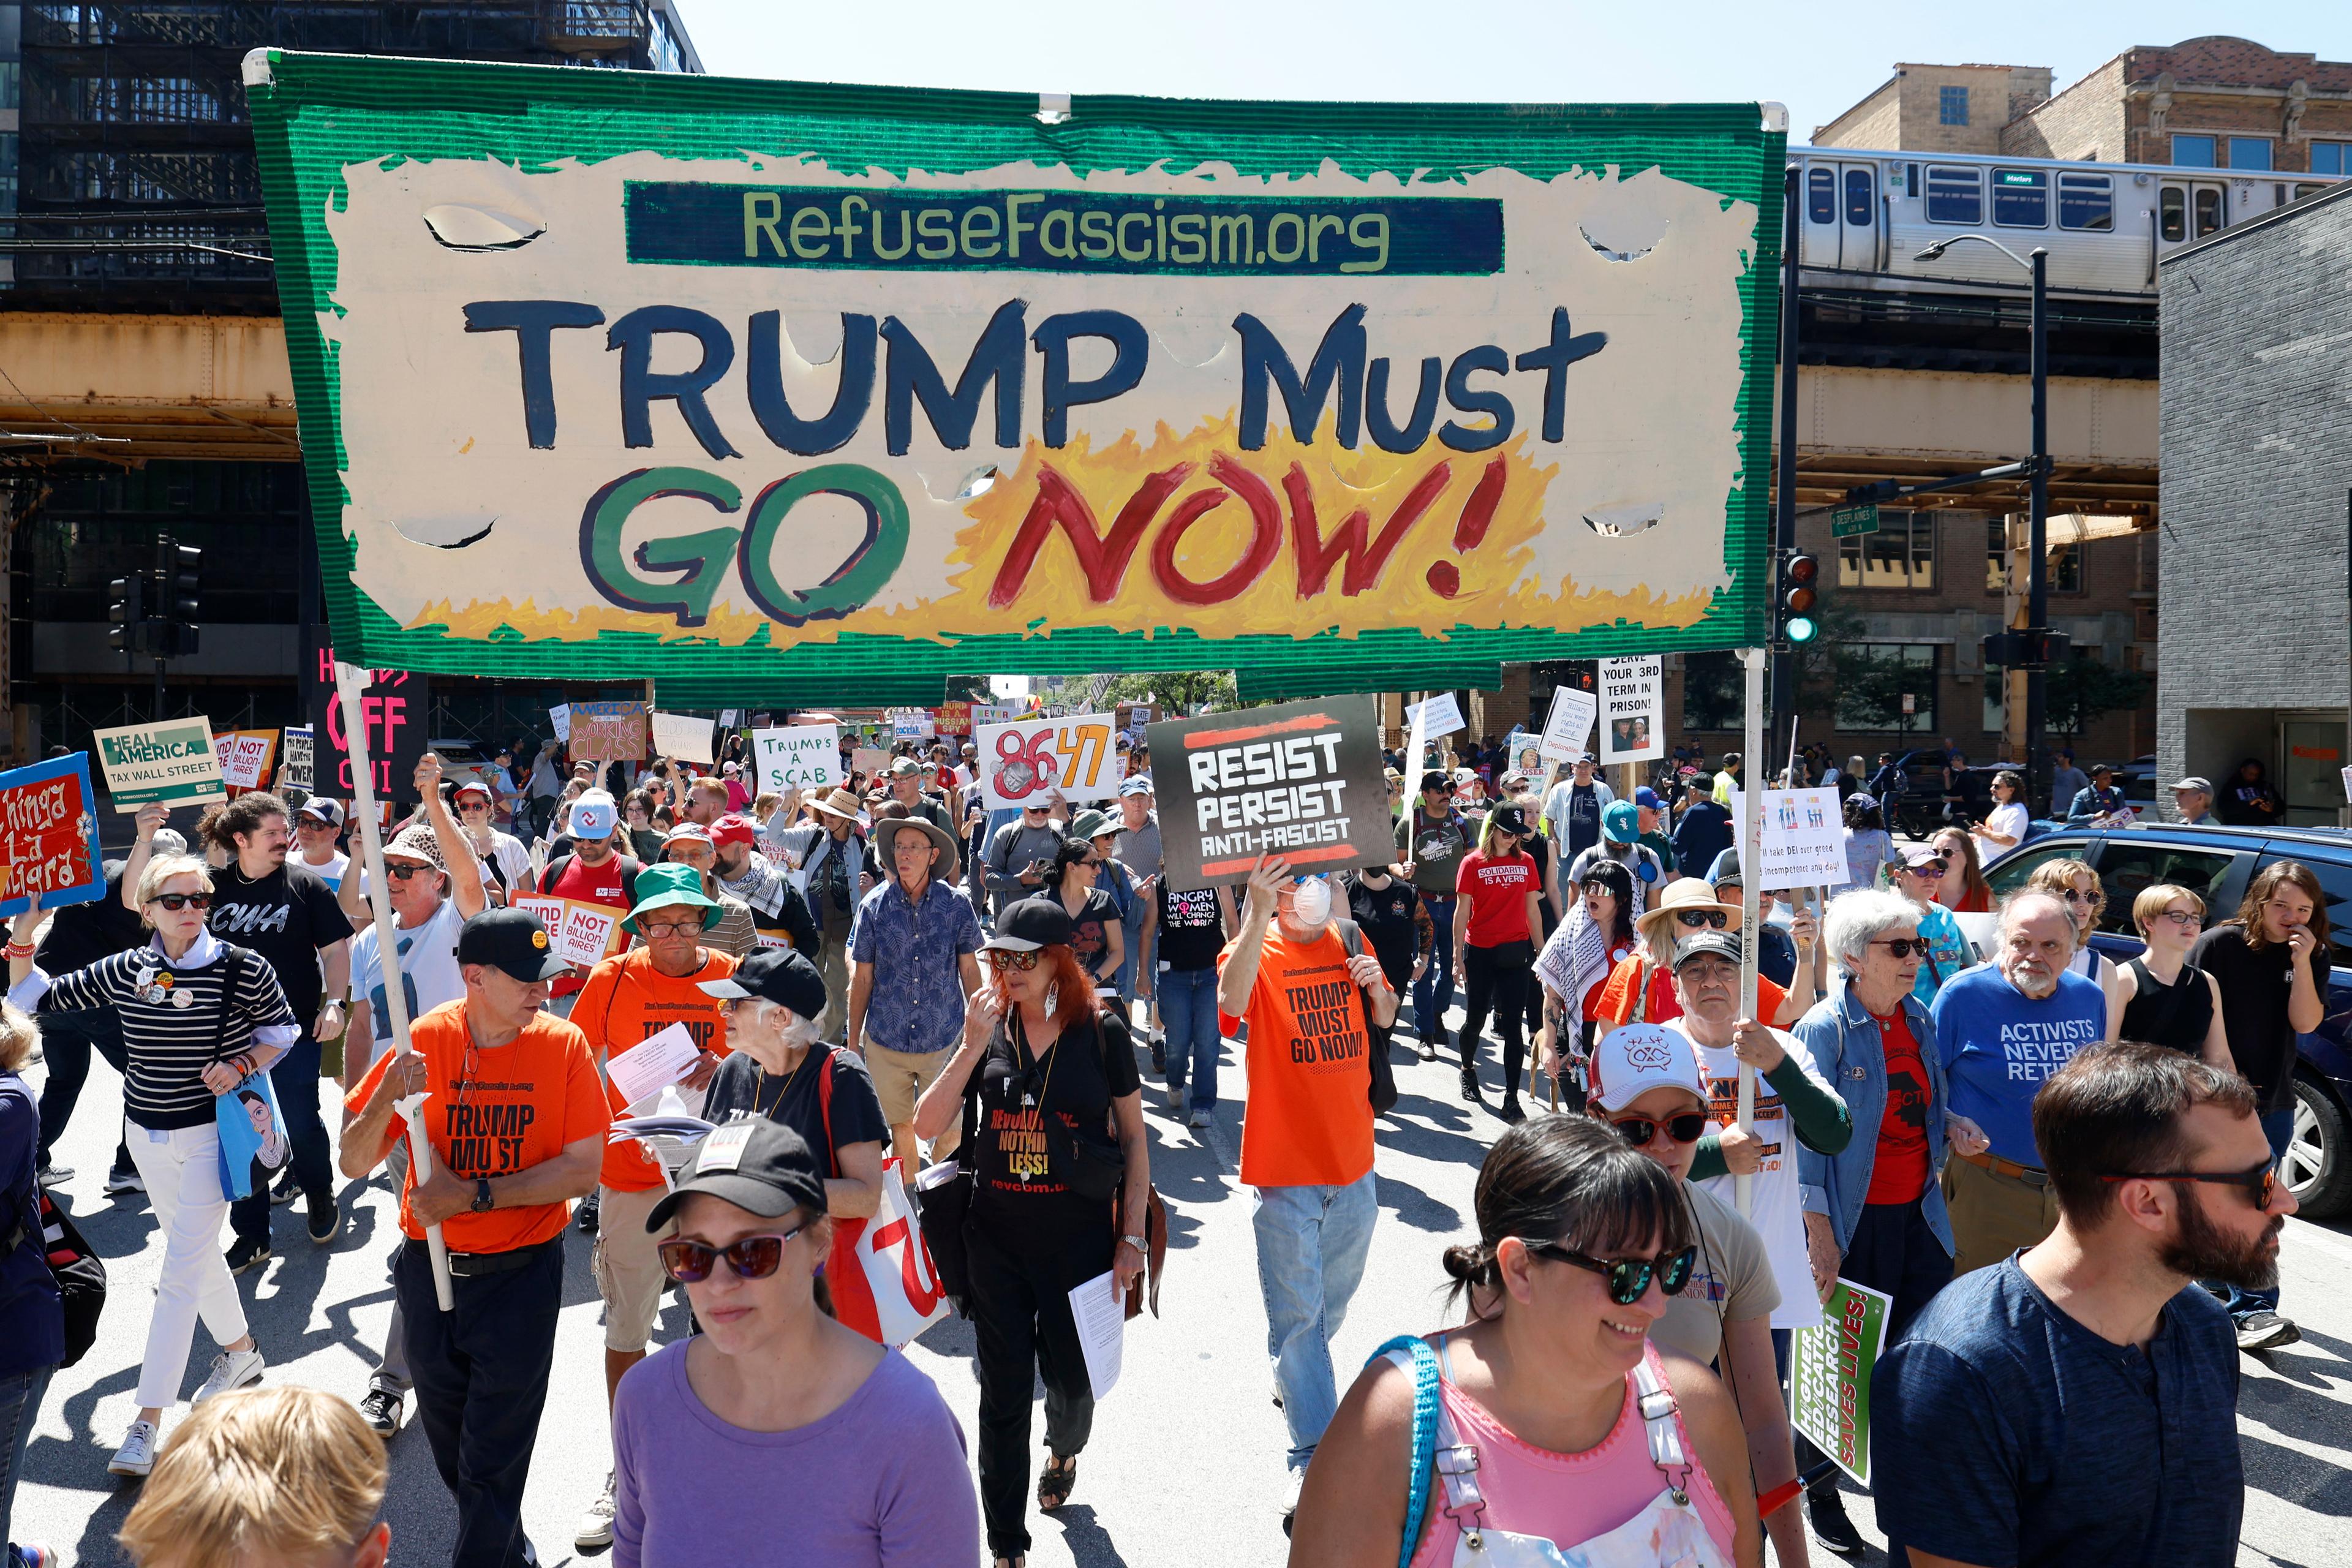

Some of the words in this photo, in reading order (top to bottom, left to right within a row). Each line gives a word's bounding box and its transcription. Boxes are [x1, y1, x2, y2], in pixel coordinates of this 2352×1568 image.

[745, 192, 1390, 274] RefuseFascism.org
[464, 297, 1149, 461] TRUMP
[1233, 301, 1610, 457] Must
[579, 463, 912, 627] GO
[987, 451, 1507, 606] NOW!
[1604, 668, 1632, 680] YOUR
[1639, 666, 1659, 677] 3RD
[1607, 684, 1636, 696] TERM
[1642, 683, 1651, 693] IN
[570, 703, 644, 715] AMERICA
[978, 710, 1008, 718] NEVER
[1051, 705, 1063, 717] NO!
[1134, 710, 1148, 720] HATE
[1567, 702, 1588, 715] Hillary,
[1610, 699, 1651, 712] PRISON!
[552, 713, 565, 722] TRUMP
[1561, 718, 1575, 727] right
[571, 720, 642, 739] WORKING
[658, 720, 682, 736] KIDS
[895, 725, 921, 735] COCKTAIL
[110, 733, 156, 752] HEAL
[238, 741, 265, 755] NOT
[296, 738, 313, 751] PEOPLE
[571, 736, 639, 760] CLASS
[671, 741, 692, 750] GUNS
[763, 737, 831, 754] TRUMP'S
[1547, 740, 1580, 754] Deplorables.
[118, 741, 197, 764] AMERICA
[290, 750, 303, 762] HAVE
[791, 753, 801, 764] A
[111, 773, 130, 783] TAX
[132, 769, 164, 781] WALL
[167, 762, 212, 776] STREET
[233, 765, 253, 774] AIRES
[1188, 733, 1342, 793] RESIST
[286, 762, 313, 784] POWER
[772, 767, 827, 786] SCAB
[0, 782, 68, 834] hinga
[1197, 780, 1346, 832] PERSIST
[1200, 818, 1350, 857] ANTI-FASCIST
[4, 831, 44, 867] La
[1770, 846, 1784, 857] take
[1787, 846, 1798, 855] DEI
[1815, 843, 1833, 856] greed
[1479, 866, 1526, 876] SOLIDARITY
[1765, 865, 1809, 876] incompetence
[1811, 863, 1823, 875] any
[1825, 861, 1839, 873] day!
[1168, 889, 1213, 903] ANGRY
[211, 903, 290, 933] CWA
[572, 912, 608, 933] NOT
[566, 925, 605, 945] BILLION-
[568, 938, 595, 953] AIRES
[1285, 981, 1352, 1013] TRUMP
[1297, 1006, 1351, 1038] MUST
[2000, 1019, 2094, 1041] ACTIVISTS
[643, 1021, 715, 1047] TRMP
[1290, 1038, 1317, 1064] GO
[1317, 1031, 1363, 1062] NOW!
[2003, 1042, 2078, 1061] NEVER
[446, 1104, 535, 1137] TRUMP
[999, 1130, 1048, 1153] NOTHI
[450, 1137, 524, 1170] MUST
[1009, 1153, 1049, 1175] LESS!
[1841, 1289, 1869, 1378] LIVES!
[1825, 1313, 1840, 1457] RESEARCH
[1841, 1381, 1858, 1469] SAVES
